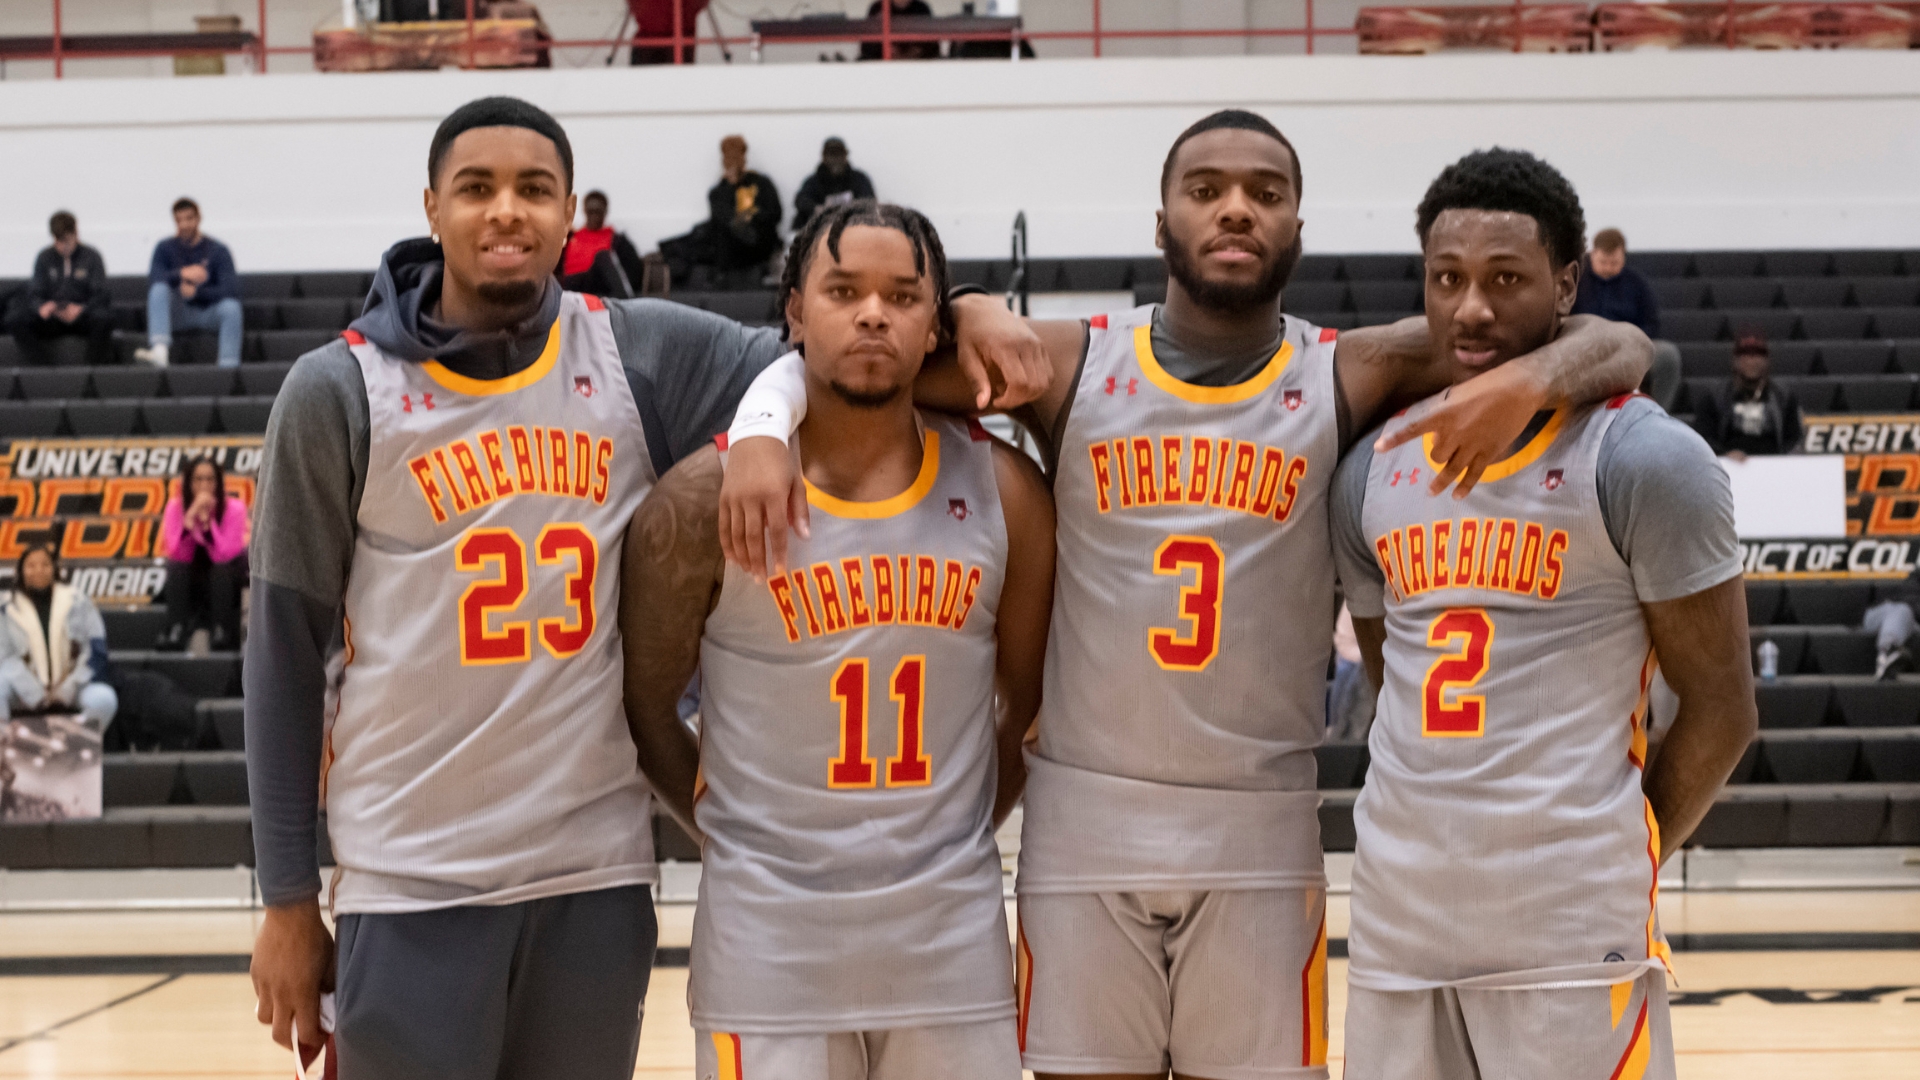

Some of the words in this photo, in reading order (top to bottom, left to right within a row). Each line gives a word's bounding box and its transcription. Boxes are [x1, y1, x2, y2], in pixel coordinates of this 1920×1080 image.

[407, 425, 613, 525] FIREBIRDS
[1089, 435, 1307, 522] FIREBIRDS
[455, 522, 598, 666] 23
[767, 554, 982, 643] FIREBIRDS
[1148, 534, 1225, 671] 3
[1375, 518, 1569, 603] FIREBIRDS
[1805, 544, 1847, 571] OF
[1848, 540, 1920, 572] COL
[827, 654, 932, 789] 11
[1421, 606, 1495, 737] 2
